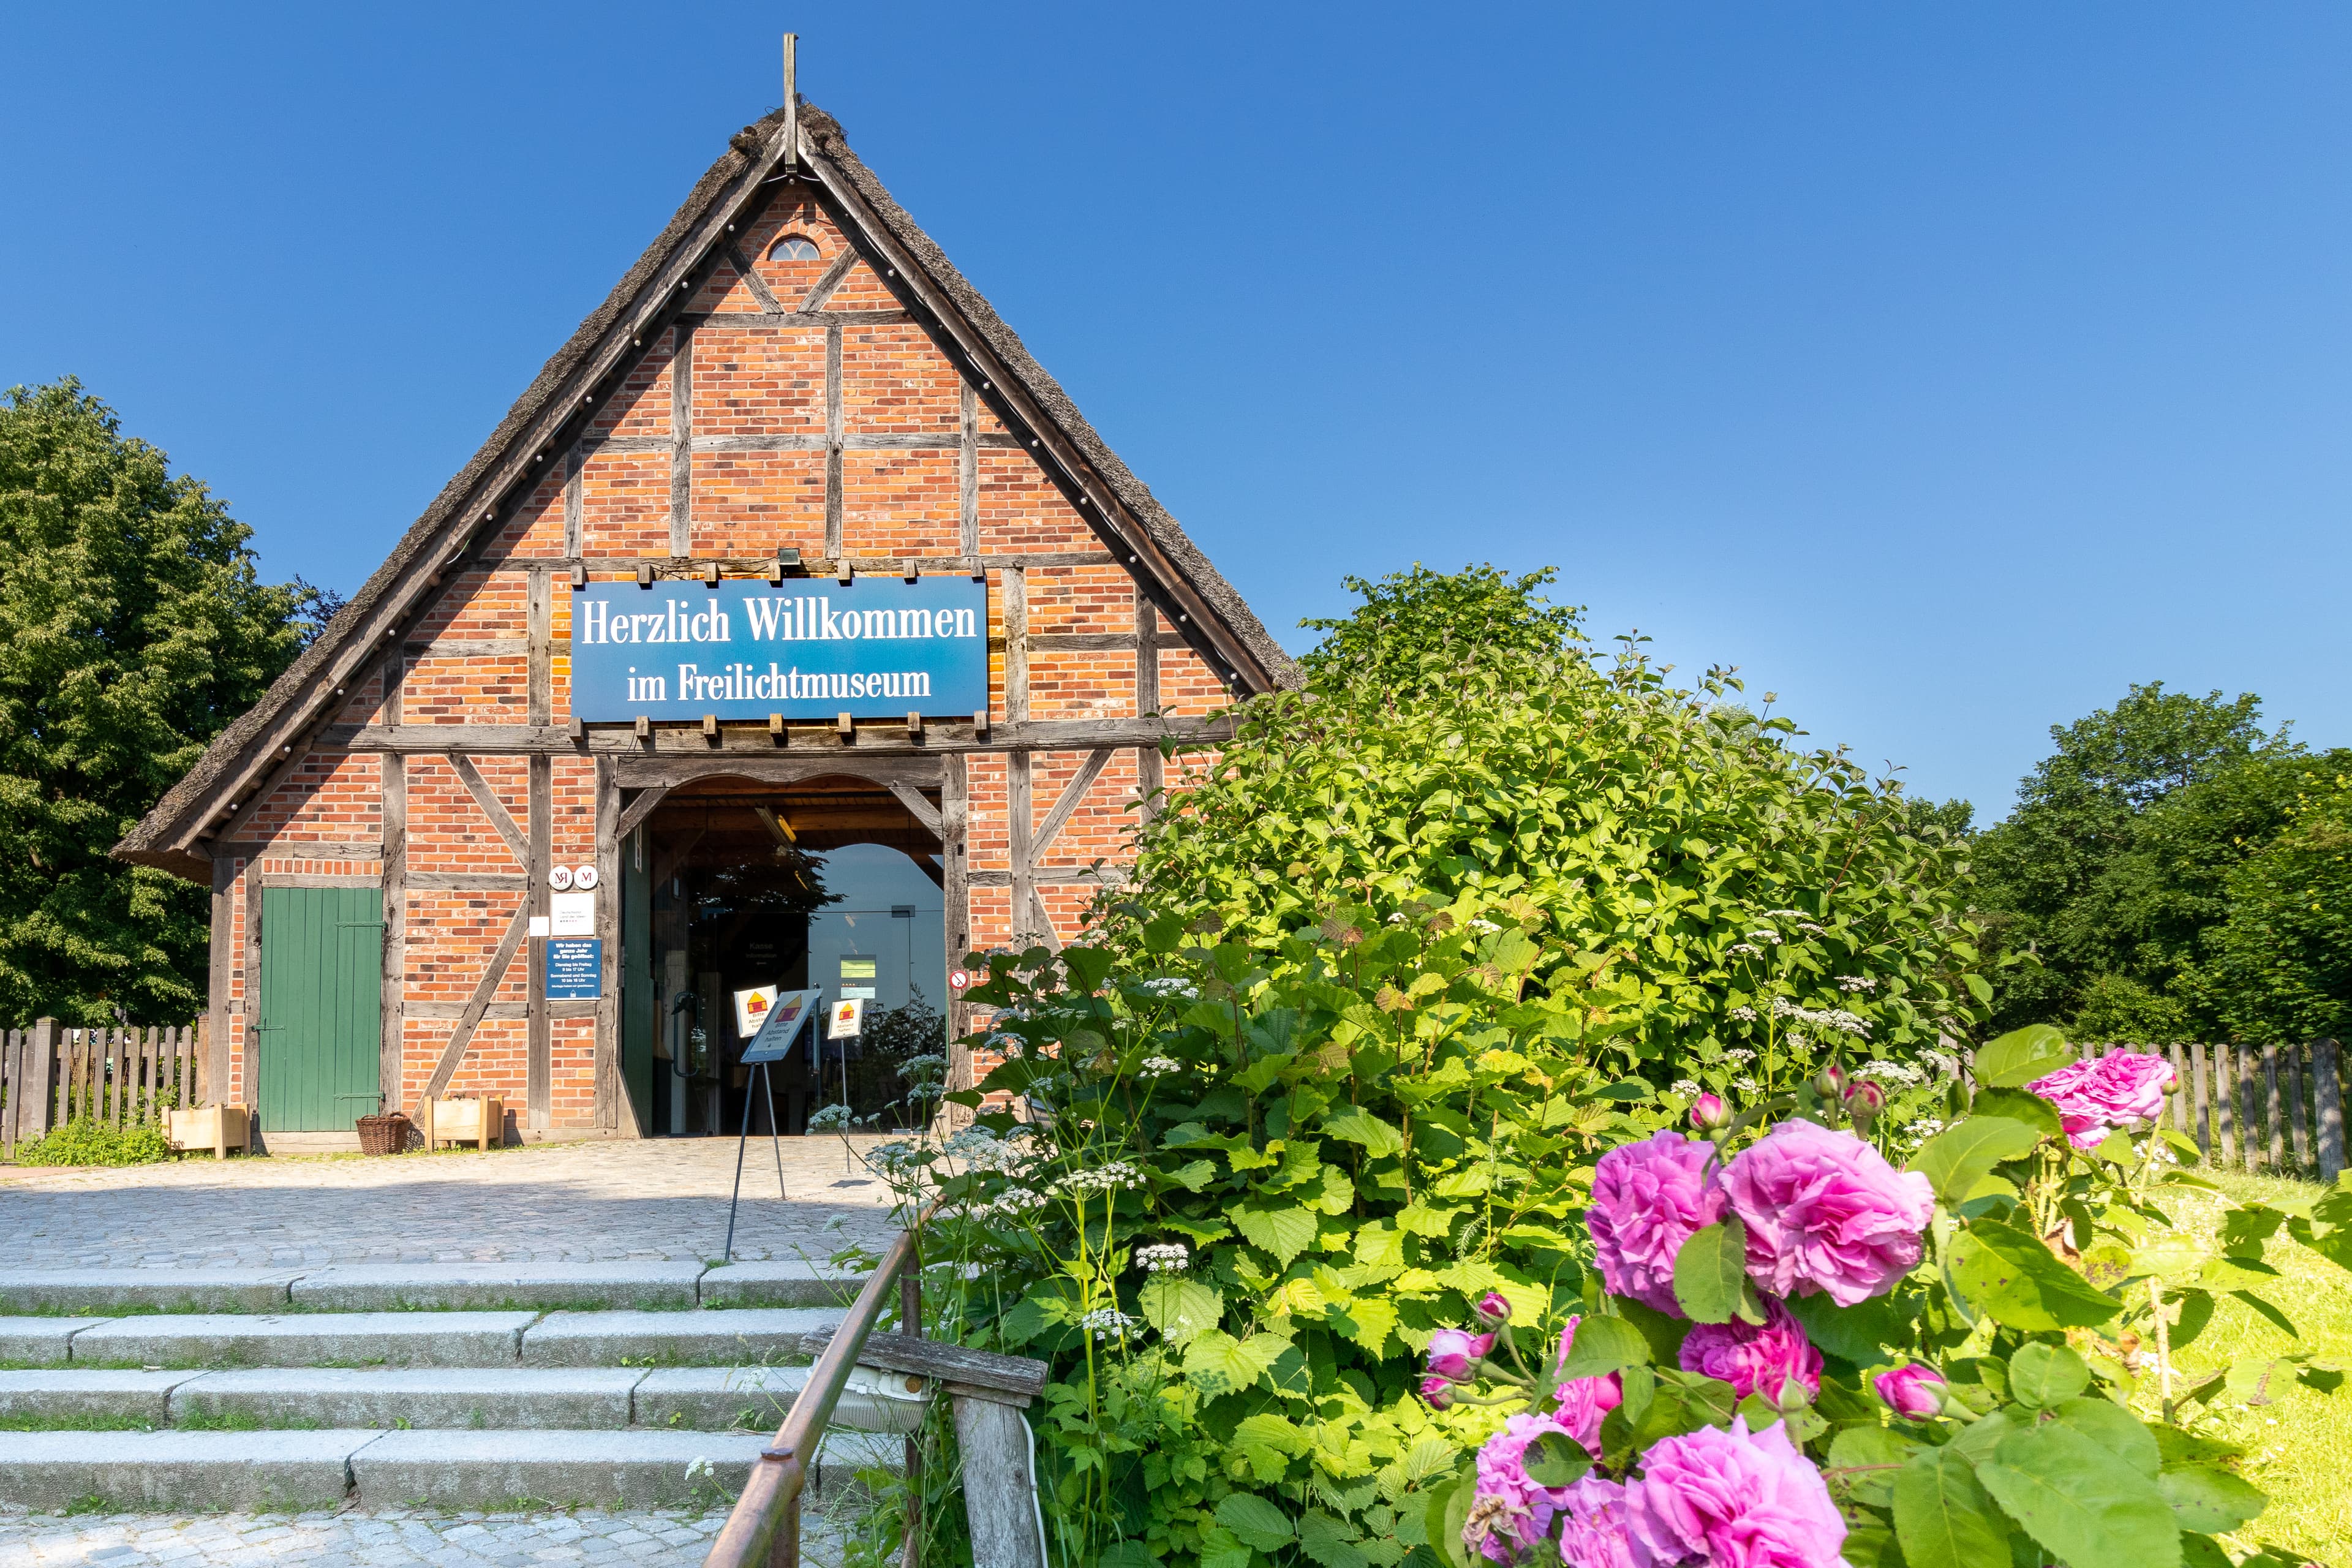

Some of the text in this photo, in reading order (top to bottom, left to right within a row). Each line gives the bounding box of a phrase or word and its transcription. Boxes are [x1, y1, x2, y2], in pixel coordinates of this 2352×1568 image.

[582, 597, 978, 644] Herzlich Willkommen
[627, 663, 931, 701] im Freilichtmuseum
